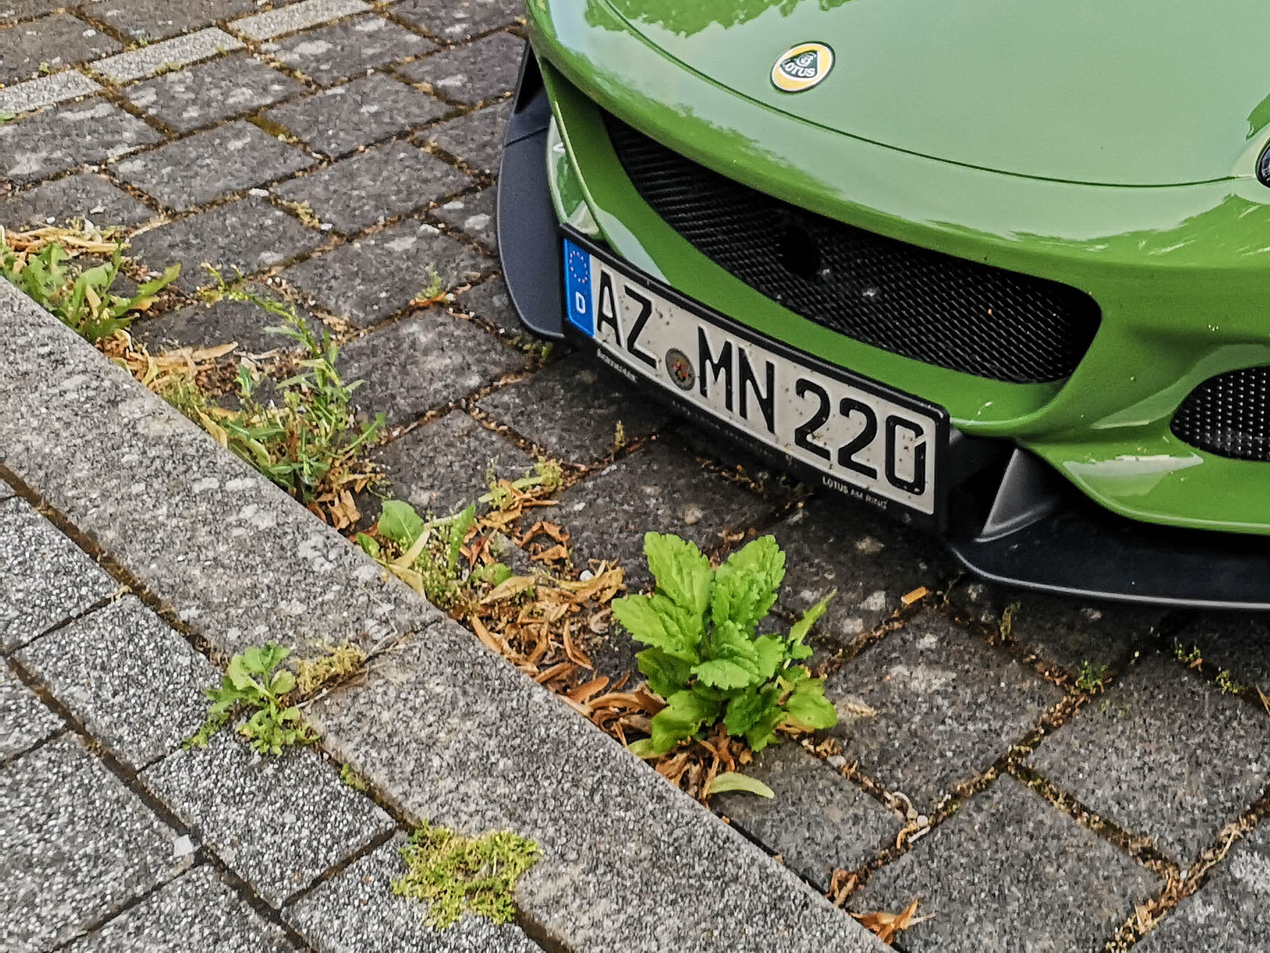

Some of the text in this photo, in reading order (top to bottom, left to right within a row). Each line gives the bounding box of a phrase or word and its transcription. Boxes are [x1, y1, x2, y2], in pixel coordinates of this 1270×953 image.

[575, 291, 586, 314] D
[597, 268, 658, 370] AZ
[698, 325, 775, 435] MN
[794, 377, 927, 496] 220
[822, 475, 849, 495] LOTUS
